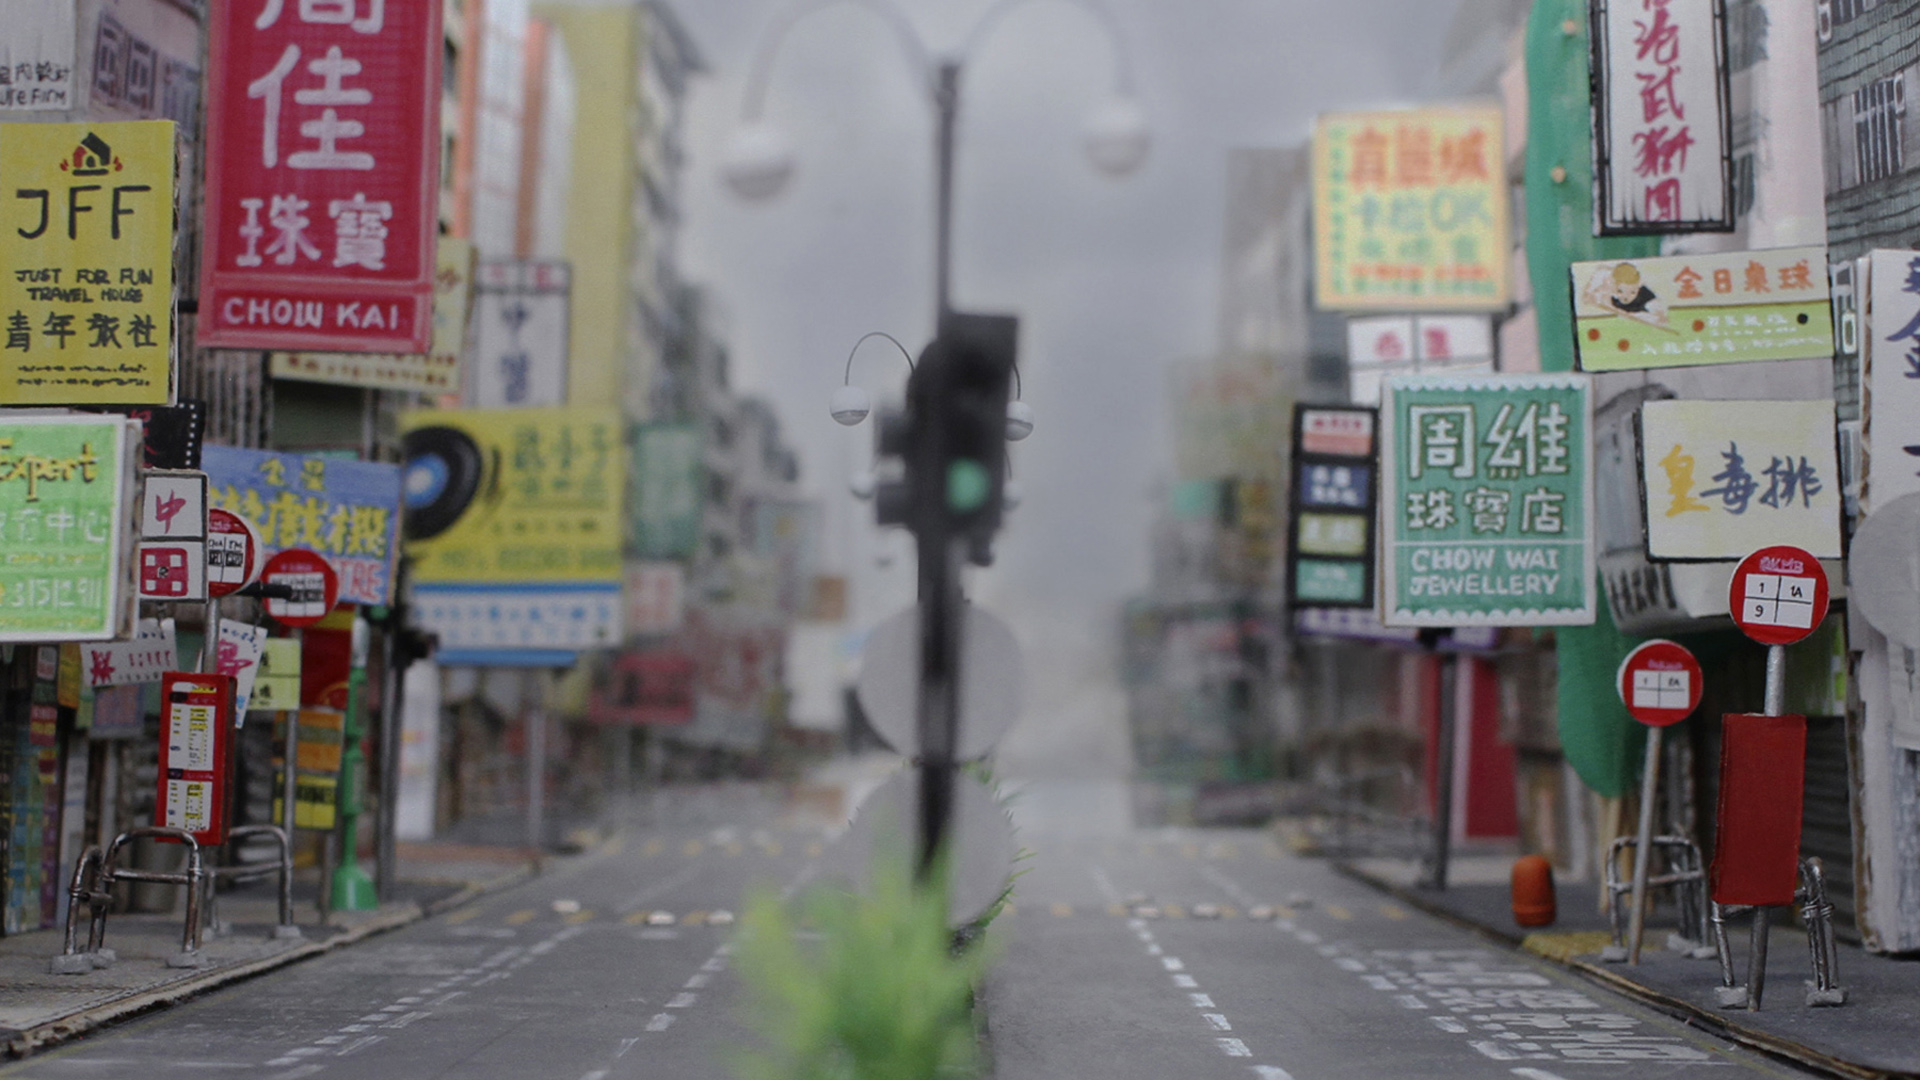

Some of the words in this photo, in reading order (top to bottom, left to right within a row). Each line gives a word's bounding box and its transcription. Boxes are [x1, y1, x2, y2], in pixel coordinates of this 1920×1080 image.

[17, 185, 152, 240] JFF
[237, 193, 393, 270] 珠寶
[15, 268, 62, 284] JUST
[76, 268, 110, 284] FOR
[120, 268, 153, 285] FUN
[26, 287, 94, 303] TRAVEL
[101, 287, 144, 303] HOUSE
[224, 297, 323, 329] CHOW
[336, 301, 398, 331] KAI
[1408, 403, 1569, 480] 周維
[1407, 488, 1565, 533] 珠寶店
[1411, 548, 1497, 572] CHOW
[1506, 548, 1559, 570] WAI
[1409, 573, 1560, 596] JEWELLERY
[1758, 582, 1765, 593] 1
[1754, 604, 1764, 617] 9
